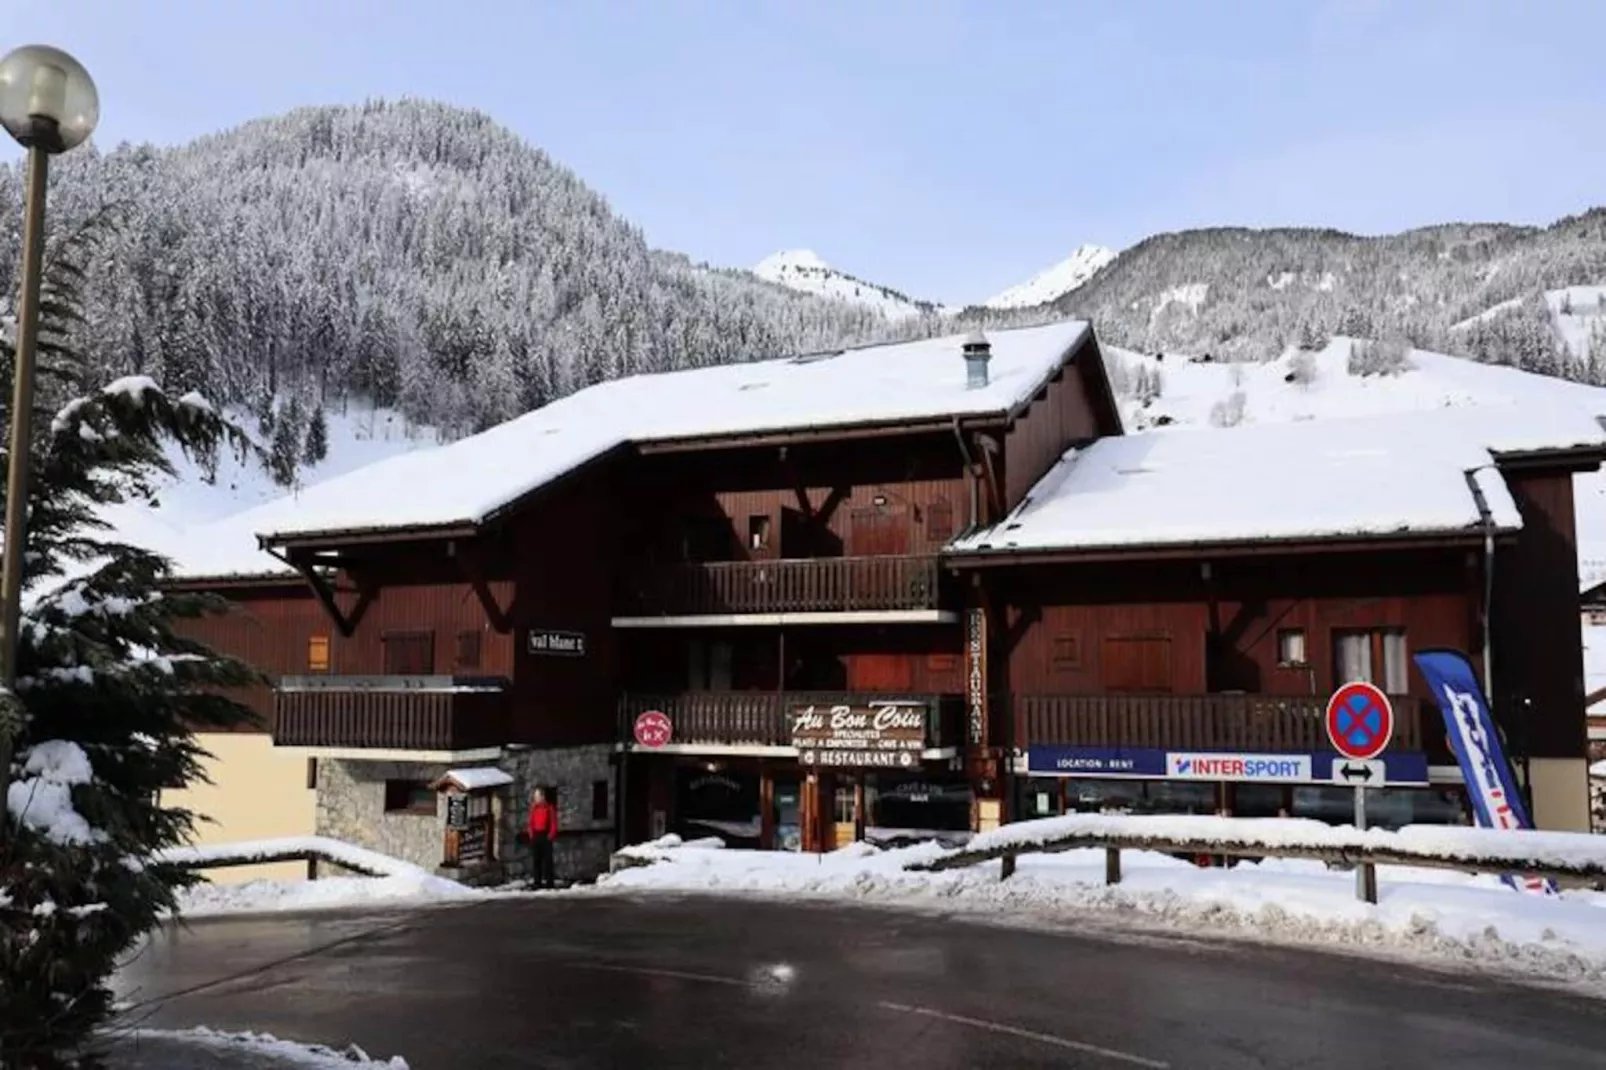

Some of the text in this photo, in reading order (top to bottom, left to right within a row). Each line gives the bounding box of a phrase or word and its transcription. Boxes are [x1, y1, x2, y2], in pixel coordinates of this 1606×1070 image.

[969, 612, 982, 743] RESTAURANT
[792, 705, 921, 733] Au Bon Coin
[820, 752, 896, 766] RESTAURANT
[1057, 759, 1102, 769] LOCATION
[1109, 759, 1134, 769] RENT
[1192, 759, 1301, 776] INTERSPORT
